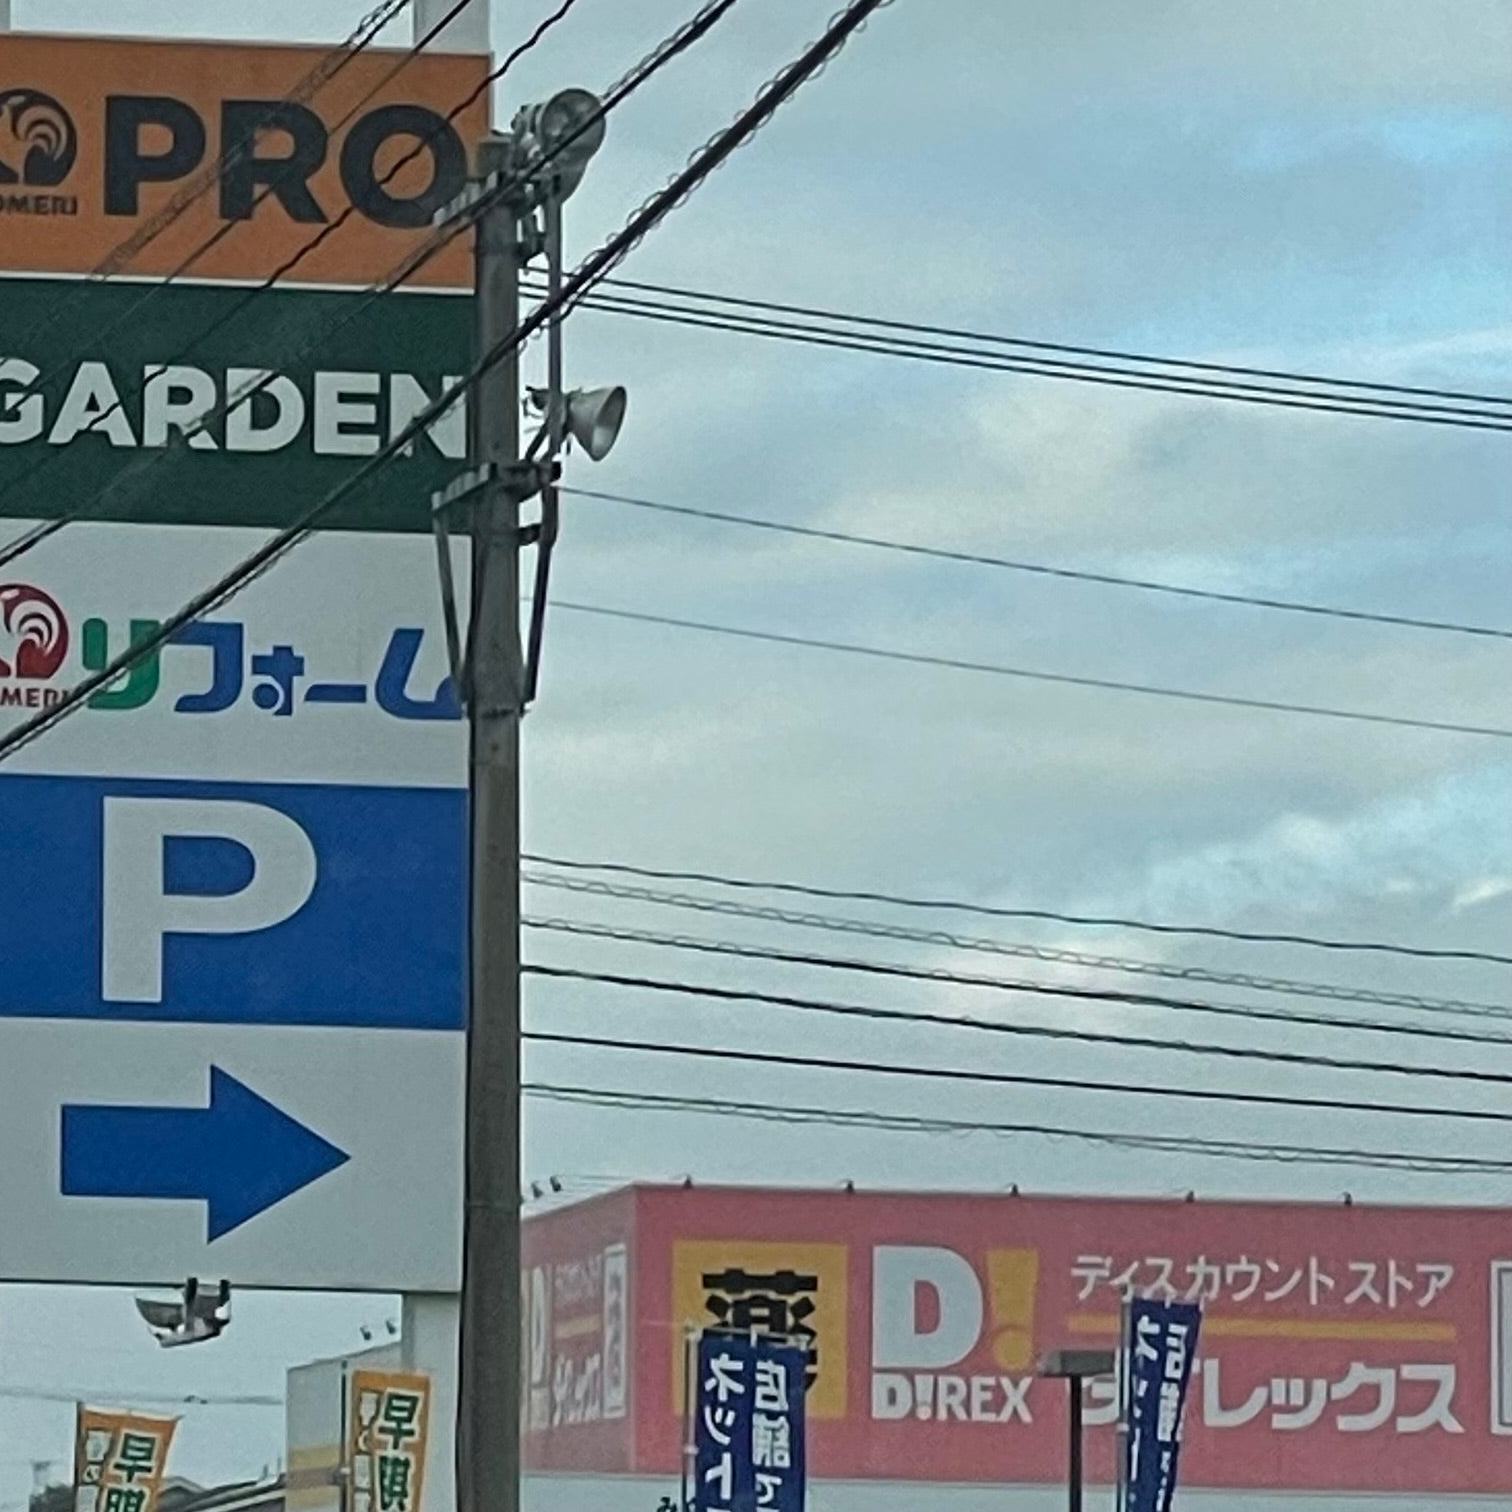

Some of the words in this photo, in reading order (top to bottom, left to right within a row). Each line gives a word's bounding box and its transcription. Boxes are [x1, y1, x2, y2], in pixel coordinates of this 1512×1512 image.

[104, 95, 468, 228] PRO
[82, 618, 465, 721] リフォーム
[103, 795, 317, 1003] P
[1071, 1254, 1455, 1309] ディスカウントストア
[1067, 1357, 1465, 1434] レックス
